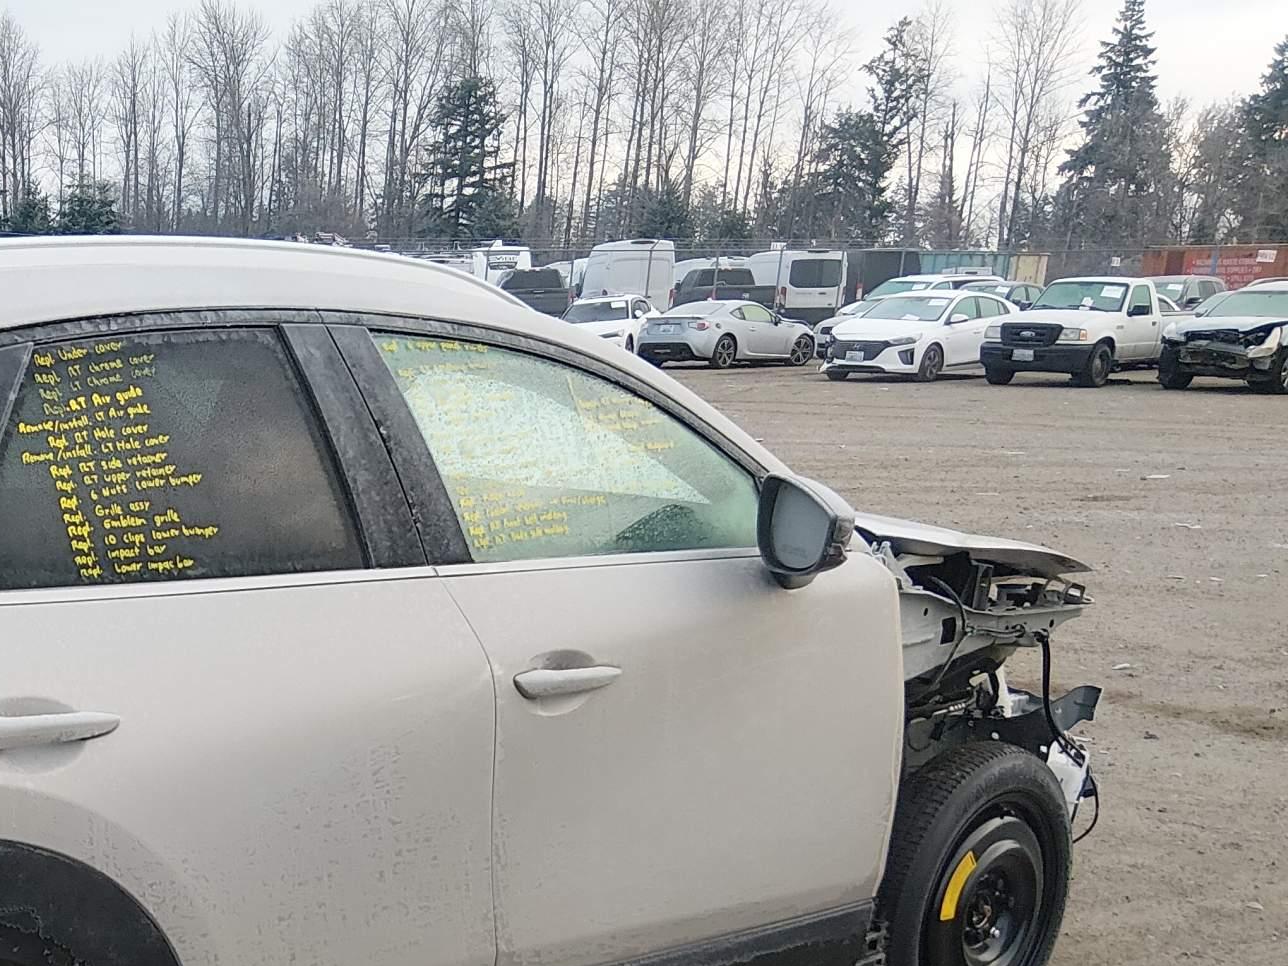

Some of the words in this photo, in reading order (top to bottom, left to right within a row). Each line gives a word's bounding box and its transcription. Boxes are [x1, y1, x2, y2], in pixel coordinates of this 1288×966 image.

[58, 347, 88, 360] Under
[95, 342, 122, 354] cover
[91, 393, 110, 407] Air
[121, 424, 148, 436] cover
[145, 435, 170, 446] cover
[147, 543, 167, 556] bar
[176, 555, 194, 569] bar
